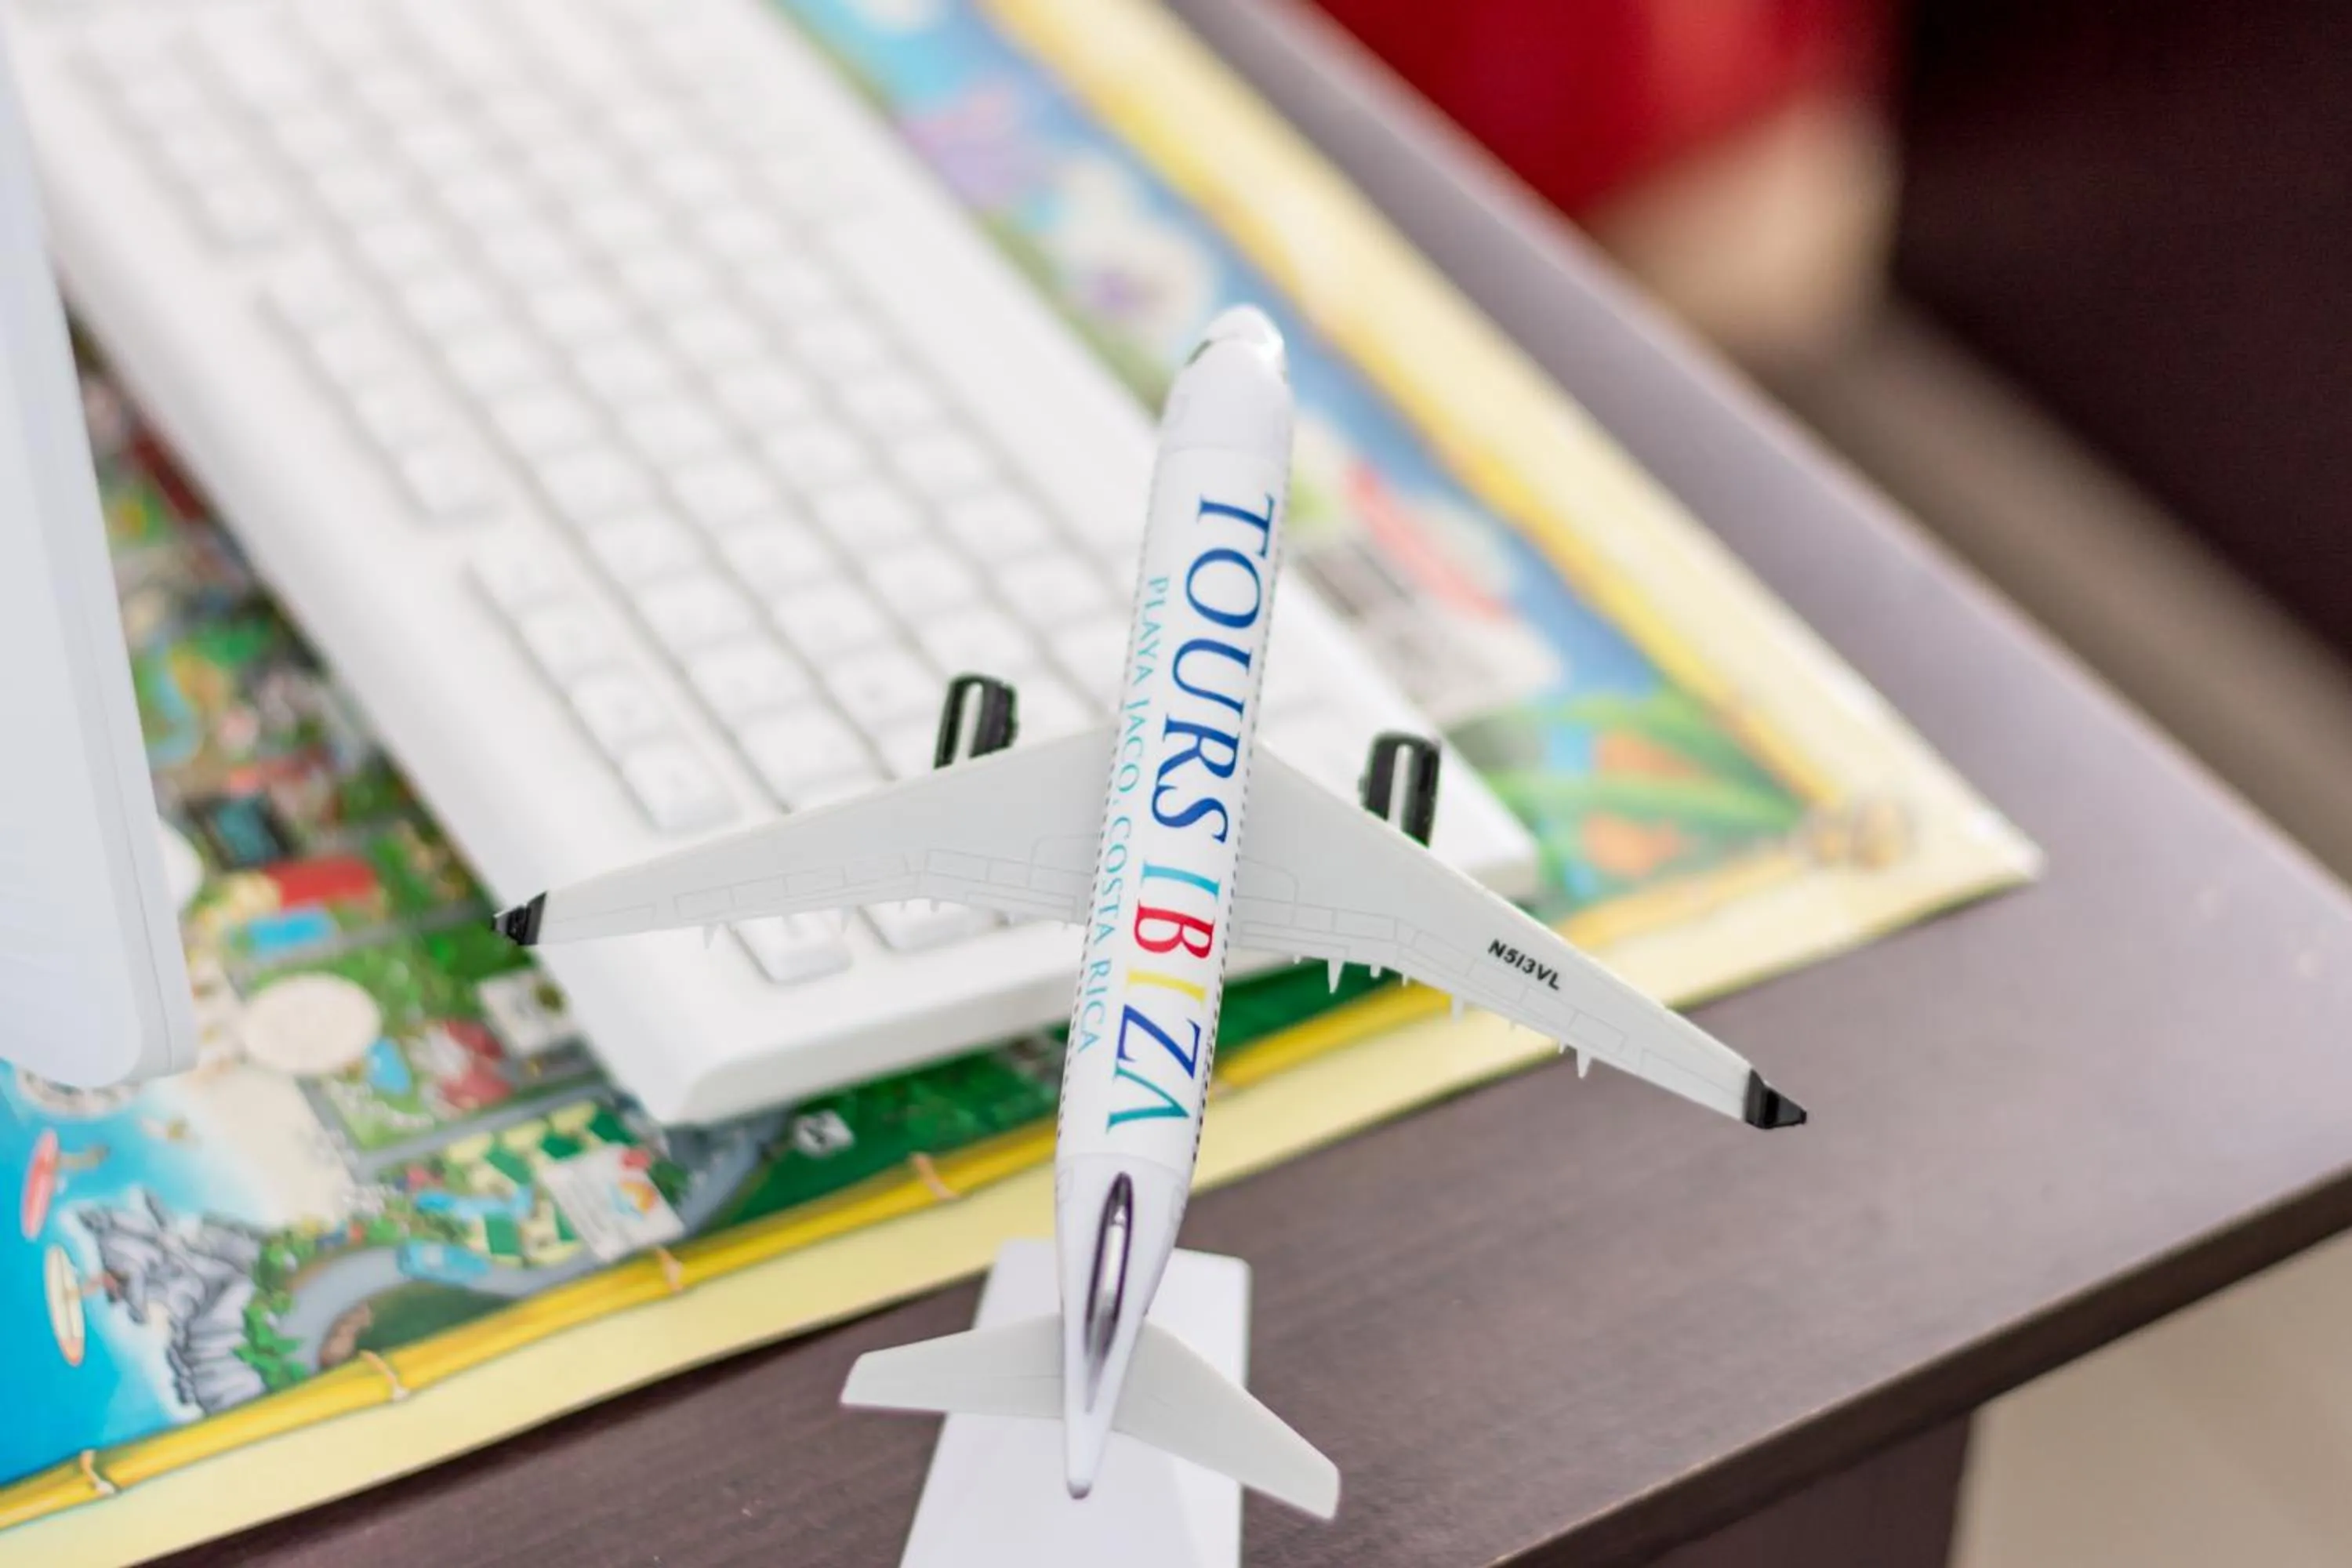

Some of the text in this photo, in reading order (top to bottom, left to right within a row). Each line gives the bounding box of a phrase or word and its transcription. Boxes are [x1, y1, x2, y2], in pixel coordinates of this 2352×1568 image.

[1133, 576, 1170, 687] PLAYA
[1106, 492, 1275, 1134] TOURS IBIZA
[1094, 815, 1131, 944] COSTA
[1077, 958, 1112, 1054] RICA
[1488, 938, 1560, 991] N513VL
